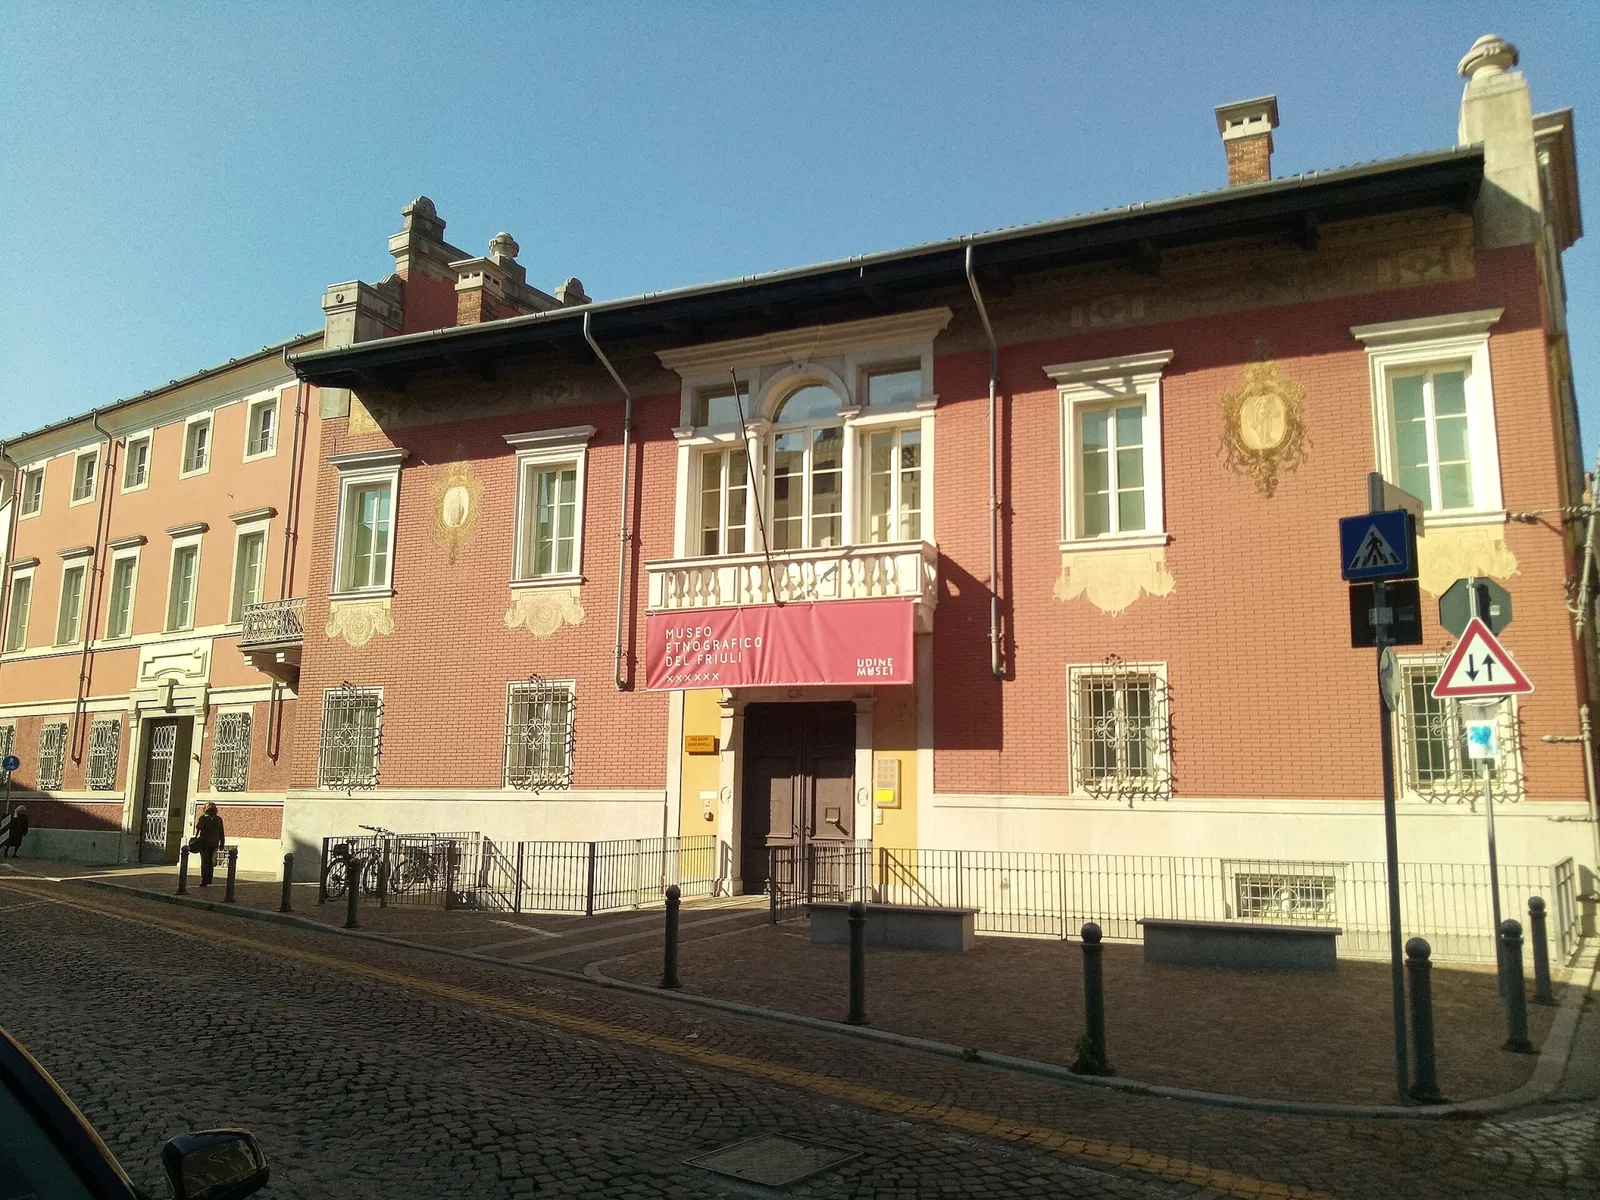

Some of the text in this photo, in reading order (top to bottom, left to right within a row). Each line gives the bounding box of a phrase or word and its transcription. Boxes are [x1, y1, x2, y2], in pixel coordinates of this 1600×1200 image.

[665, 626, 712, 640] MUSEO
[665, 637, 763, 653] ETNOGRAFICO
[665, 652, 742, 667] DEL FRIULI
[856, 657, 893, 667] UDINE
[856, 667, 893, 676] MUSEI
